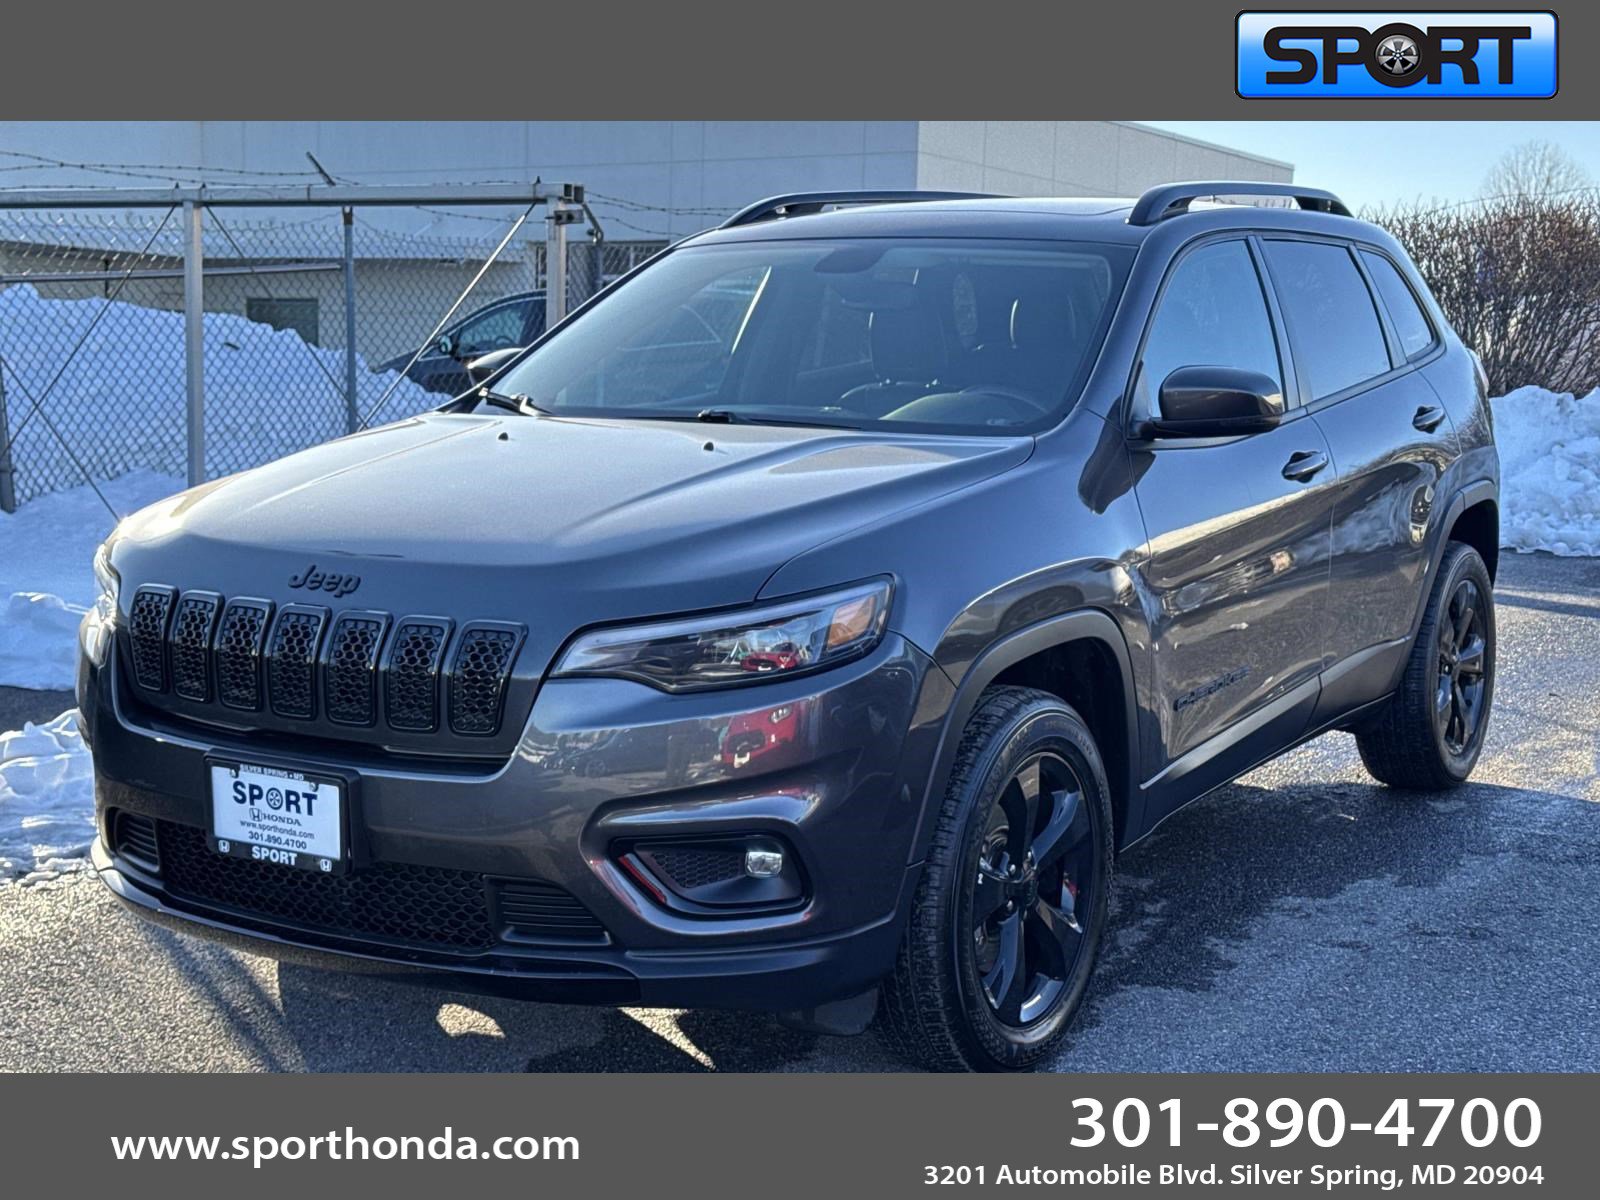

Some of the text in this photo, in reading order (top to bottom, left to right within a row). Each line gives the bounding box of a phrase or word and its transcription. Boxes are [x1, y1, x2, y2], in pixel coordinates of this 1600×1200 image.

[288, 564, 361, 598] Jeep
[232, 780, 318, 816] SPORT
[240, 820, 315, 839] www.sporthonda.com
[262, 812, 302, 827] HONDA
[248, 830, 307, 850] 301.890.4700
[251, 845, 298, 866] SPORT
